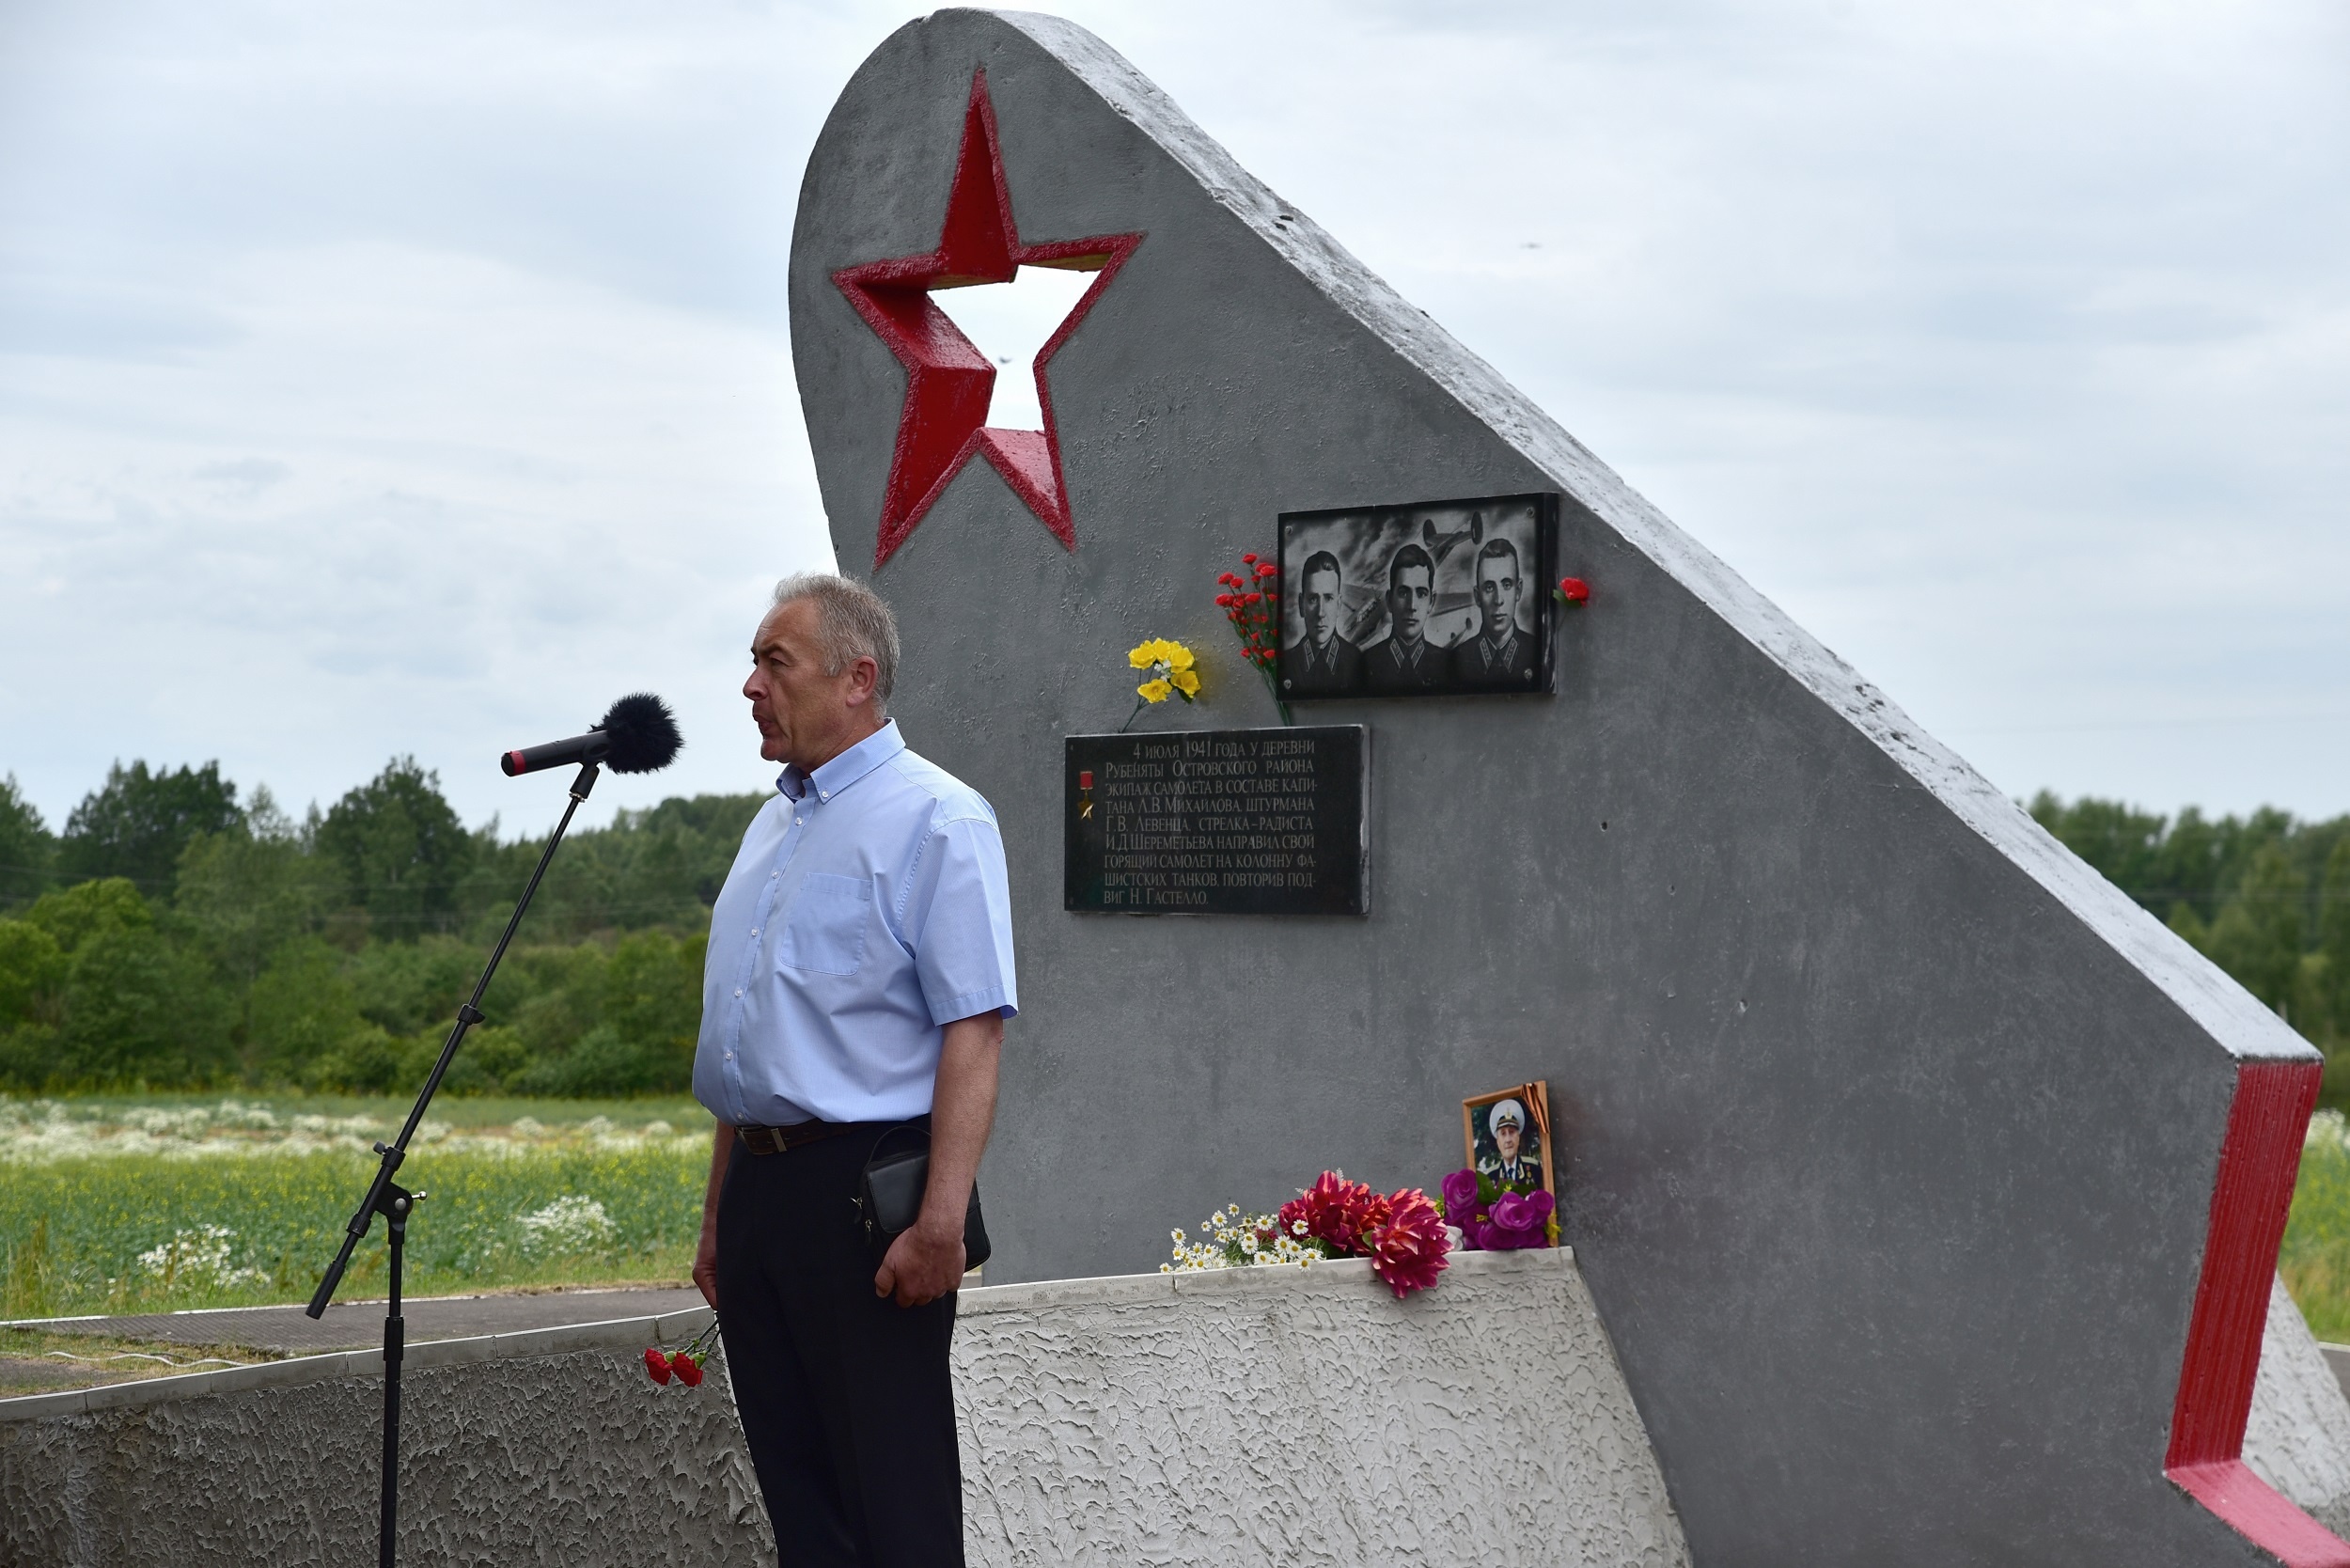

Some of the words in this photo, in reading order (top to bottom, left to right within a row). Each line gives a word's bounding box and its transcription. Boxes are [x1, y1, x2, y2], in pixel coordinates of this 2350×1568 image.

[1133, 743, 1141, 759] 4
[1145, 745, 1180, 759] ИЮЛЯ
[1186, 741, 1211, 758] 1941
[1215, 743, 1246, 758] ГОДА
[1250, 742, 1259, 756] У
[1261, 741, 1315, 757] ДЕРЕВНИ
[1105, 762, 1165, 778] РУБЕНЯТЫ
[1172, 760, 1257, 777] ОСТРОВСКОГО
[1266, 759, 1314, 774] РАЙОНА
[1105, 782, 1152, 796] ЭКИПАЖ
[1153, 780, 1213, 795] САМОЛЕТА
[1215, 780, 1223, 793] В
[1226, 779, 1279, 793] СОСТАВЕ
[1282, 778, 1318, 792] КАПИ-
[1105, 801, 1135, 814] ТАНА
[1246, 797, 1315, 812] ШТУРМАНА
[1106, 815, 1129, 832] Г.В.
[1130, 834, 1214, 850] ШЕРЕМЕТЬЕВА
[1216, 836, 1279, 849] НАПРАВИЛ
[1282, 834, 1315, 849] СВОЙ
[1104, 855, 1157, 870] ГОРЯЩИЙ
[1159, 855, 1214, 869] САМОЛЕТ
[1216, 855, 1232, 868] НА
[1236, 855, 1293, 868] КОЛОННУ
[1297, 854, 1317, 868] ФА-
[1104, 873, 1167, 886] ШИСТСКИХ
[1223, 872, 1284, 886] ПОВТОРИВ
[1288, 872, 1317, 887] ПОД-
[1104, 890, 1125, 904] ВИГ
[1130, 888, 1143, 904] Н.
[1147, 888, 1210, 904] ГАСТЕЛЛО.
